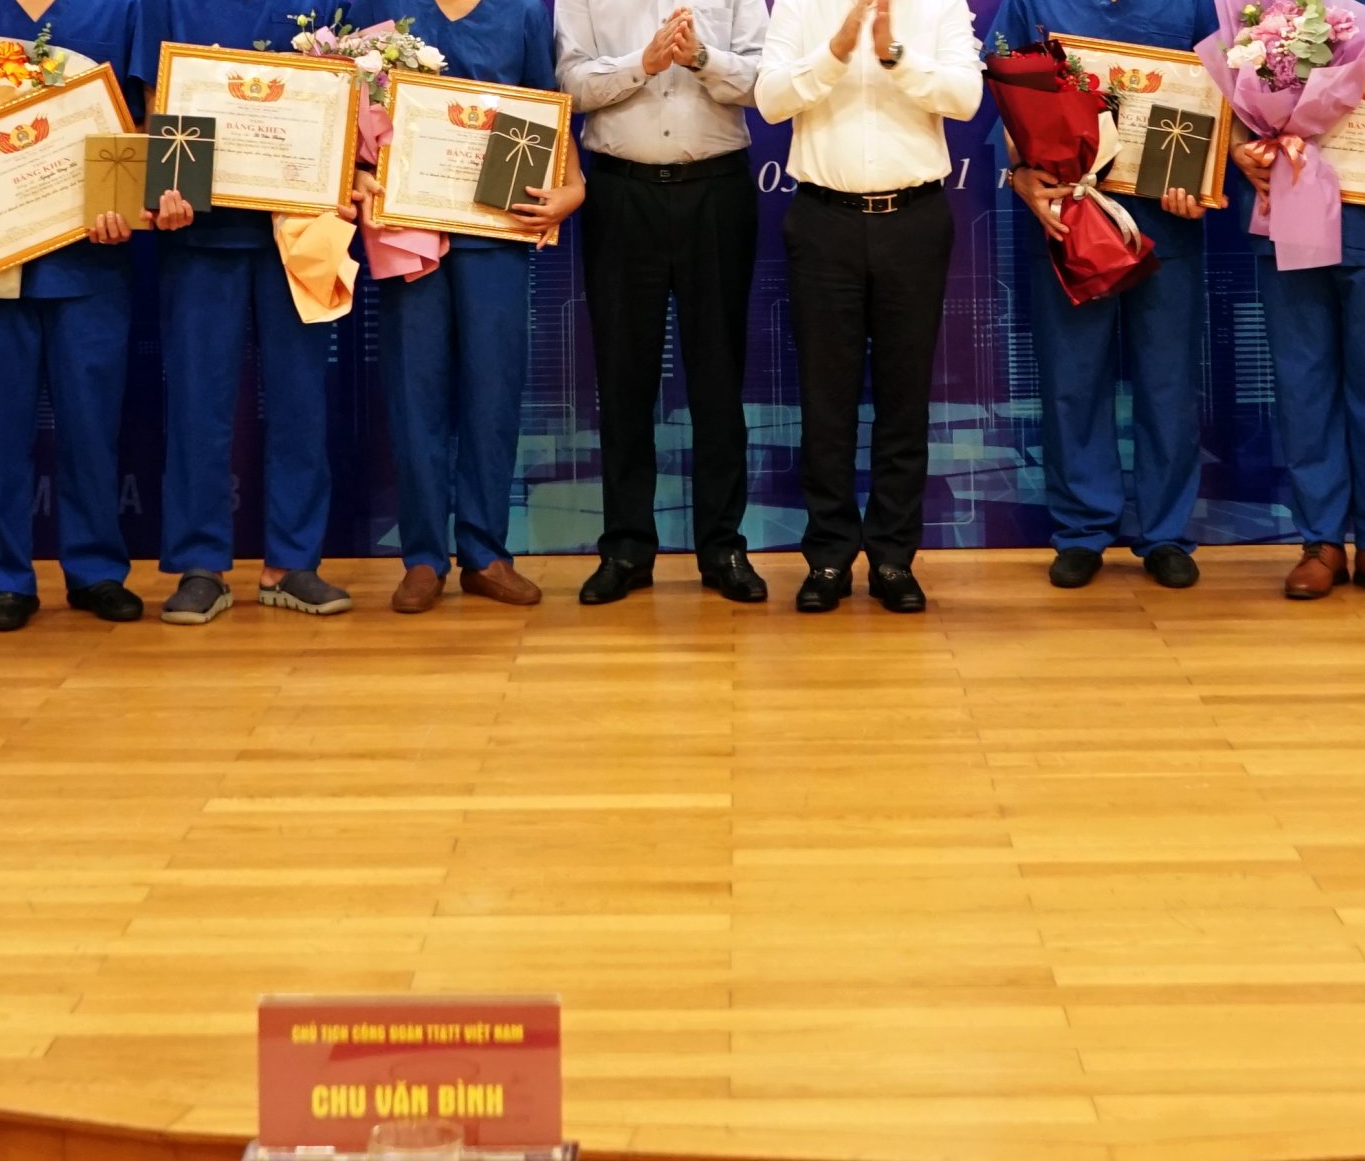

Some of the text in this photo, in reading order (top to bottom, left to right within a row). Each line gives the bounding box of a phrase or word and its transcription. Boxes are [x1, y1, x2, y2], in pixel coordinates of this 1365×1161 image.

[311, 1078, 504, 1117] CHU VĂN BÌNH
